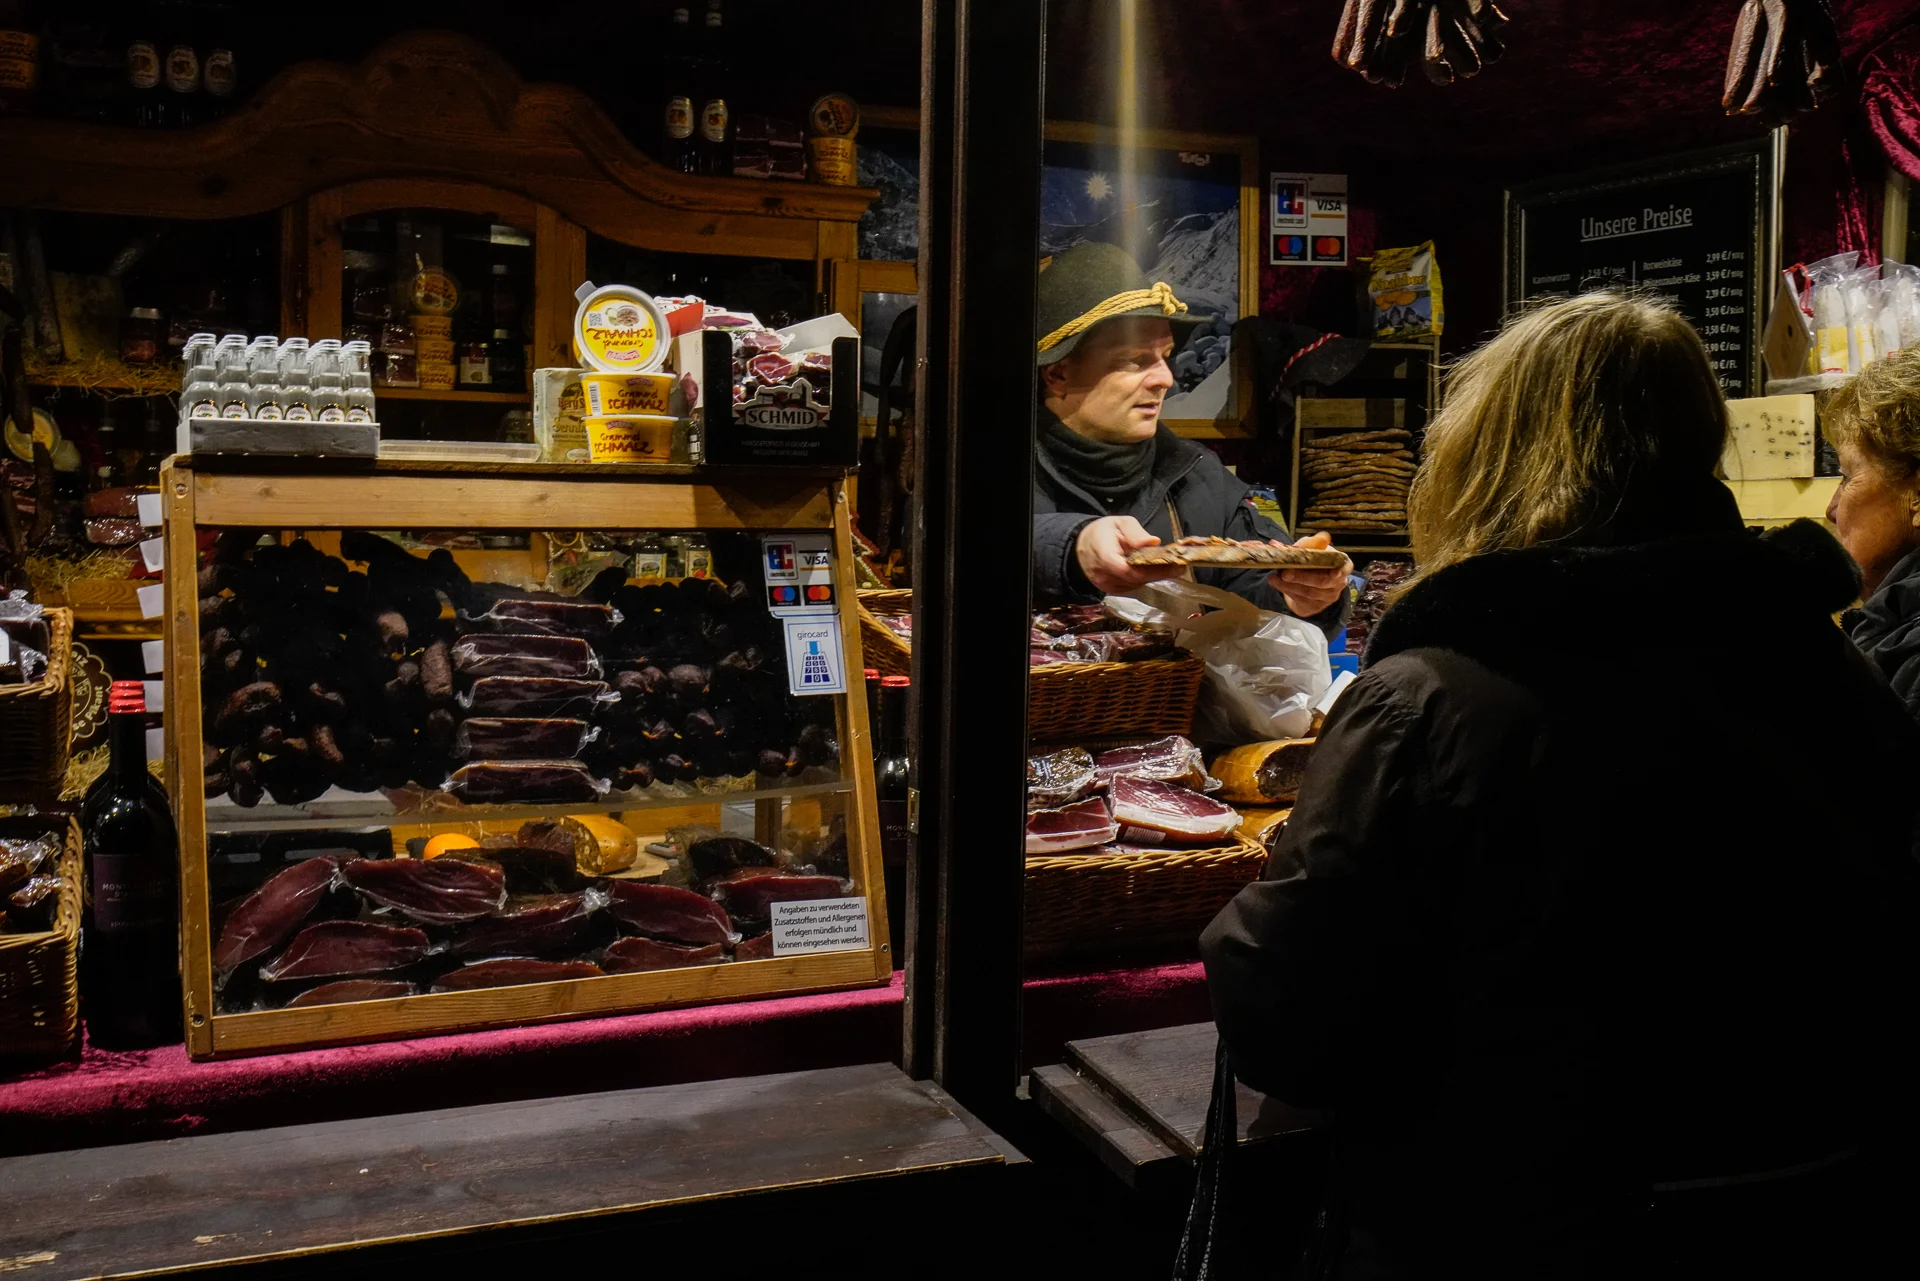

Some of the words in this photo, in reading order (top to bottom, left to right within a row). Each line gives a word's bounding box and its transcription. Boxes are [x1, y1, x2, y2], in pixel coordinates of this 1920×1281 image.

[1317, 200, 1342, 211] VISA
[1581, 215, 1637, 239] Unsere
[1643, 204, 1693, 230] Preise
[586, 328, 653, 340] SCHMALZ
[607, 399, 666, 412] SCHMALZ
[749, 410, 814, 425] SCHMID
[594, 441, 654, 454] SCHMALZ
[803, 555, 829, 565] VISA
[797, 630, 829, 641] girocard
[779, 905, 809, 915] Angaben
[818, 902, 860, 912] verwendeten
[774, 915, 818, 926] Zusatzstoffen
[818, 914, 831, 923] und
[832, 913, 866, 923] Allergenen
[785, 928, 812, 938] erfolgen
[813, 926, 843, 935] mündlich
[844, 924, 857, 932] und
[777, 941, 802, 949] können
[803, 938, 840, 948] eingesehen
[840, 936, 866, 944] werden.
